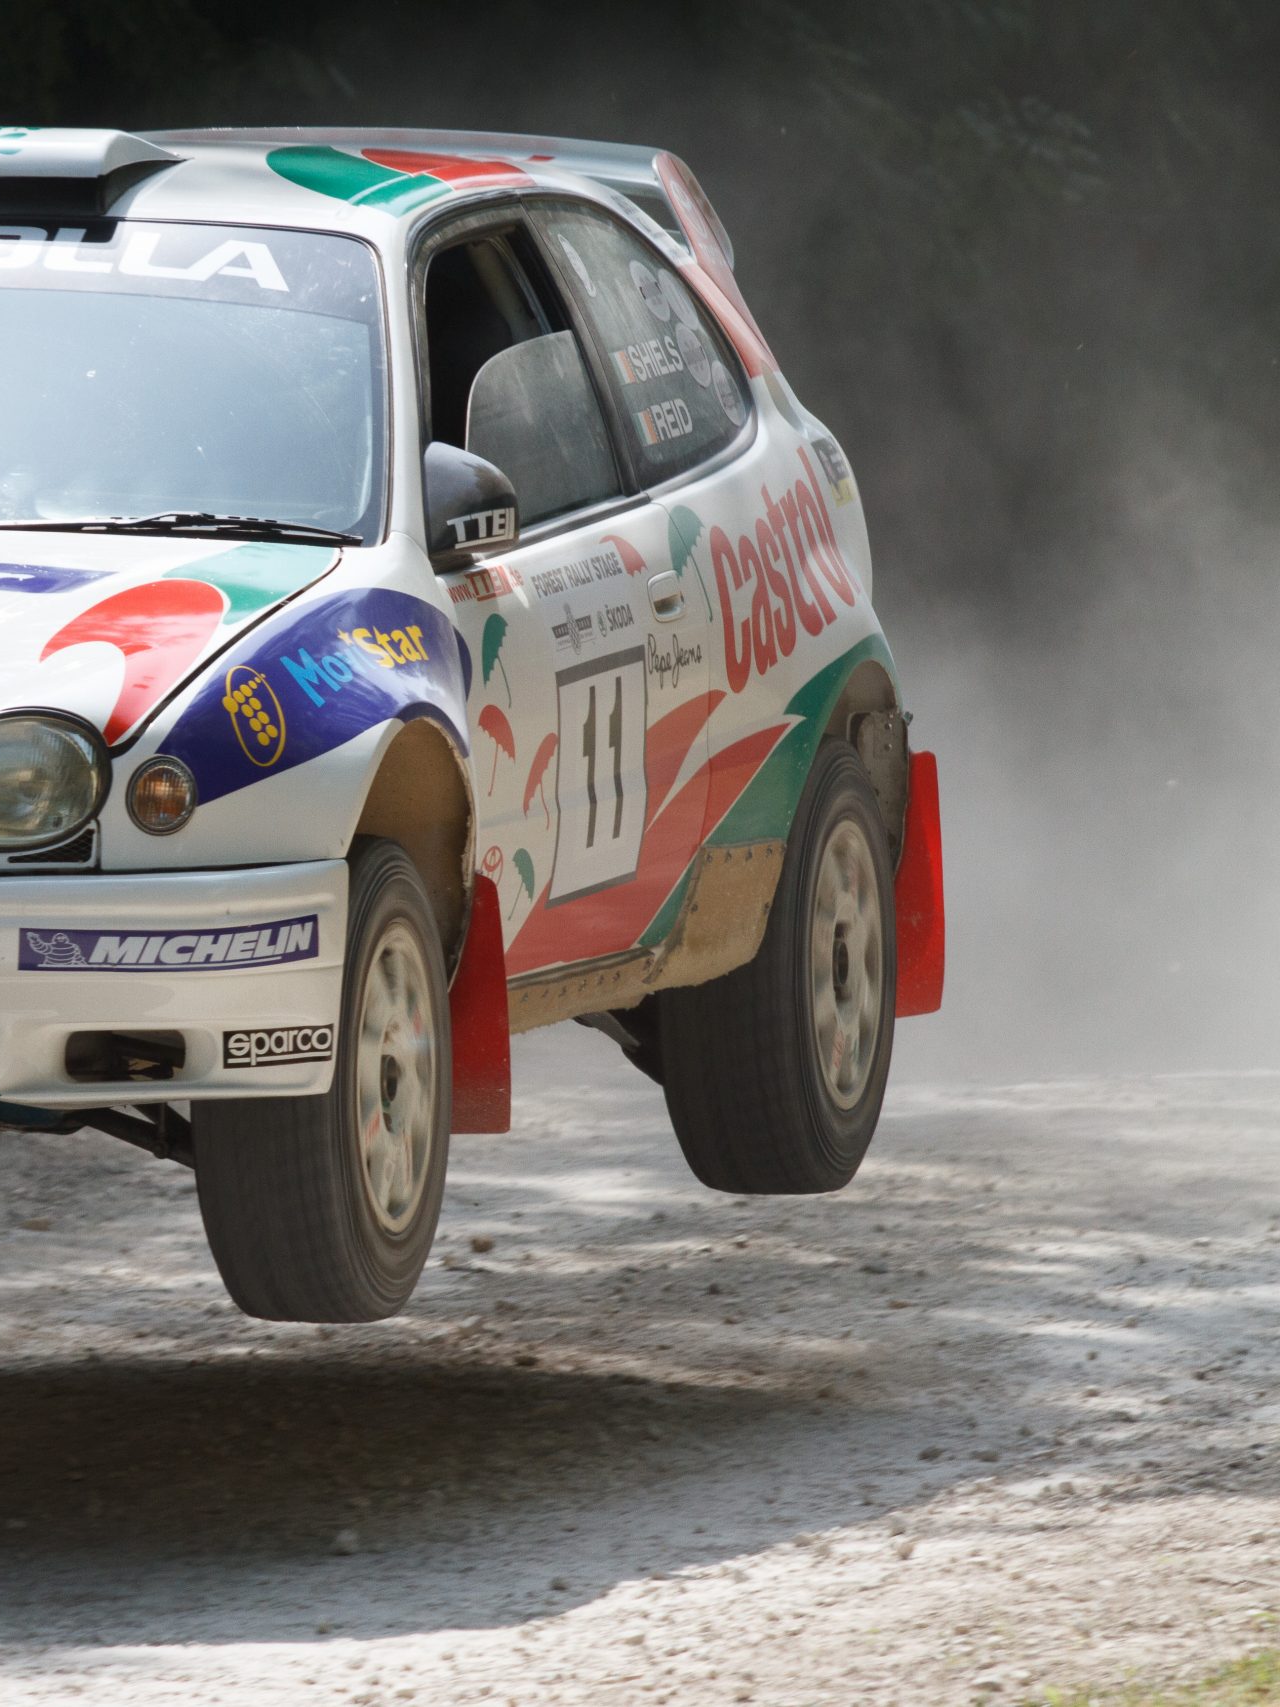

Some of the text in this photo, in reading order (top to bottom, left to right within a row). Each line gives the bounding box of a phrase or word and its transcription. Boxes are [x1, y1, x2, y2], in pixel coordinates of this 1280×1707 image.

[628, 335, 684, 382] SHIELS
[650, 398, 693, 441] REID
[532, 551, 622, 598] FOREST RALLY STAGE
[710, 446, 858, 694] Castrol
[605, 604, 634, 631] ŠKODA
[280, 624, 429, 708] MoviStar
[583, 676, 624, 848] 11
[88, 921, 313, 965] MICHELIN
[227, 1026, 333, 1066] sparco
